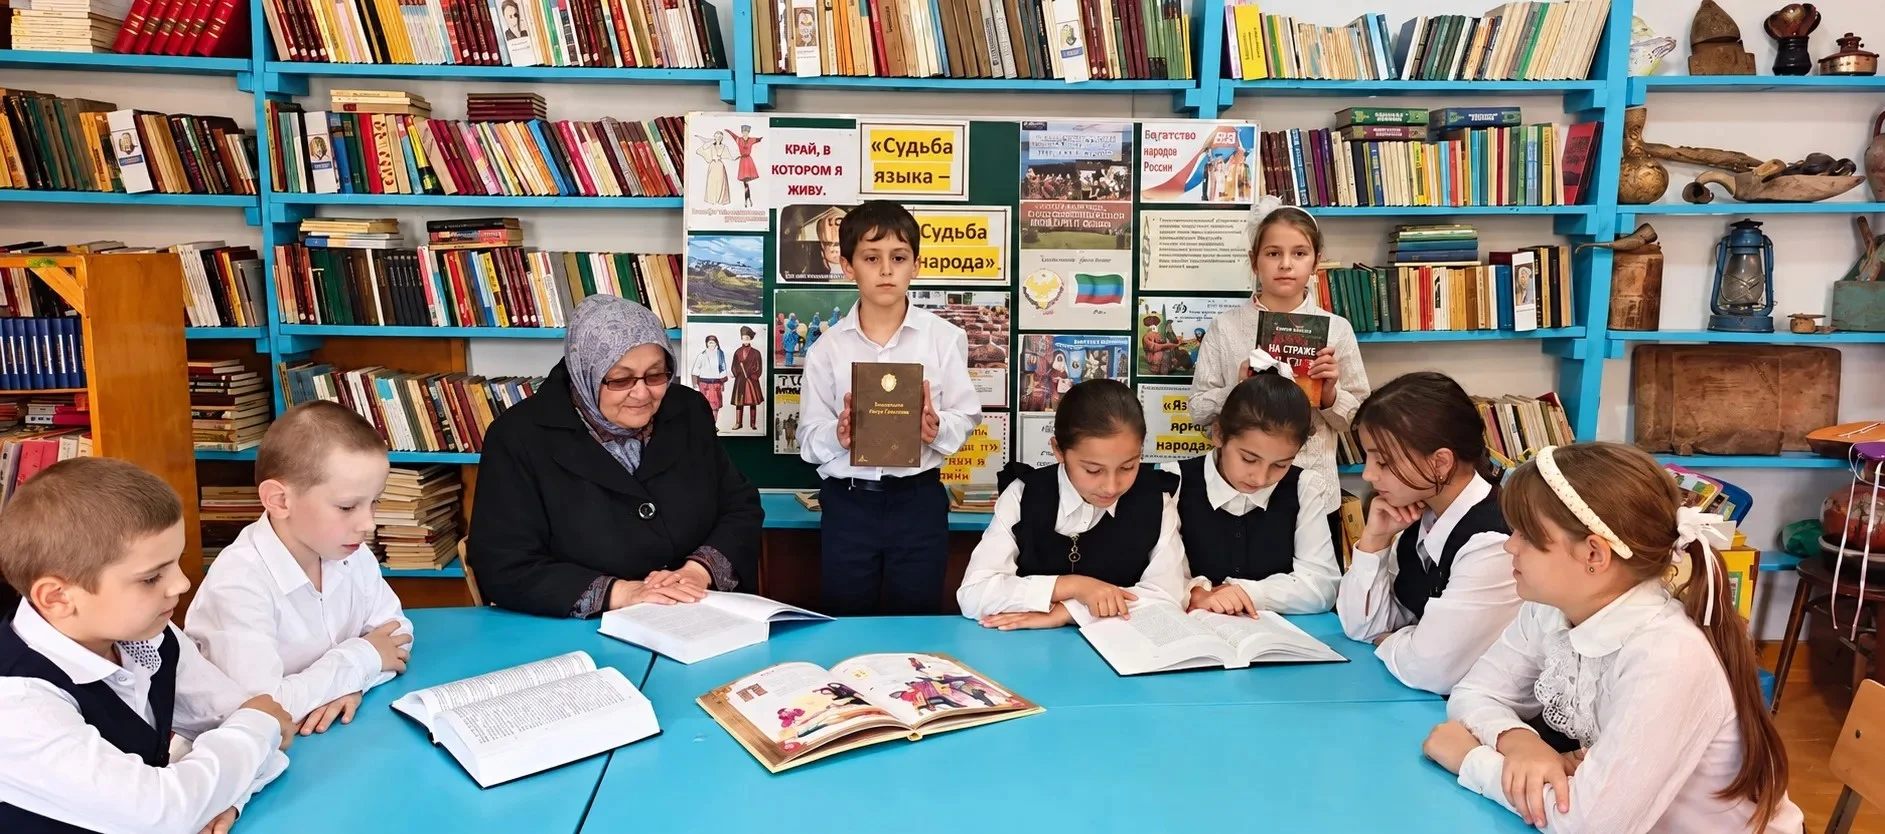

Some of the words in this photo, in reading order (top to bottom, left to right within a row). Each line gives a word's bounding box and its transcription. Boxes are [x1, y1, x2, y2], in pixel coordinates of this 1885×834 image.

[1144, 129, 1197, 142] Богатство
[785, 142, 820, 157] КРАЙ,
[823, 145, 831, 155] В
[871, 137, 953, 158] «Судьба
[771, 164, 832, 175] КОТОРОМ
[834, 165, 843, 176] Я
[1143, 161, 1173, 172] России
[874, 171, 933, 184] языка
[787, 184, 826, 196] ЖИВУ.
[920, 223, 987, 242] Судьба
[1268, 343, 1281, 353] НА
[1283, 345, 1317, 356] СТРАЖЕ
